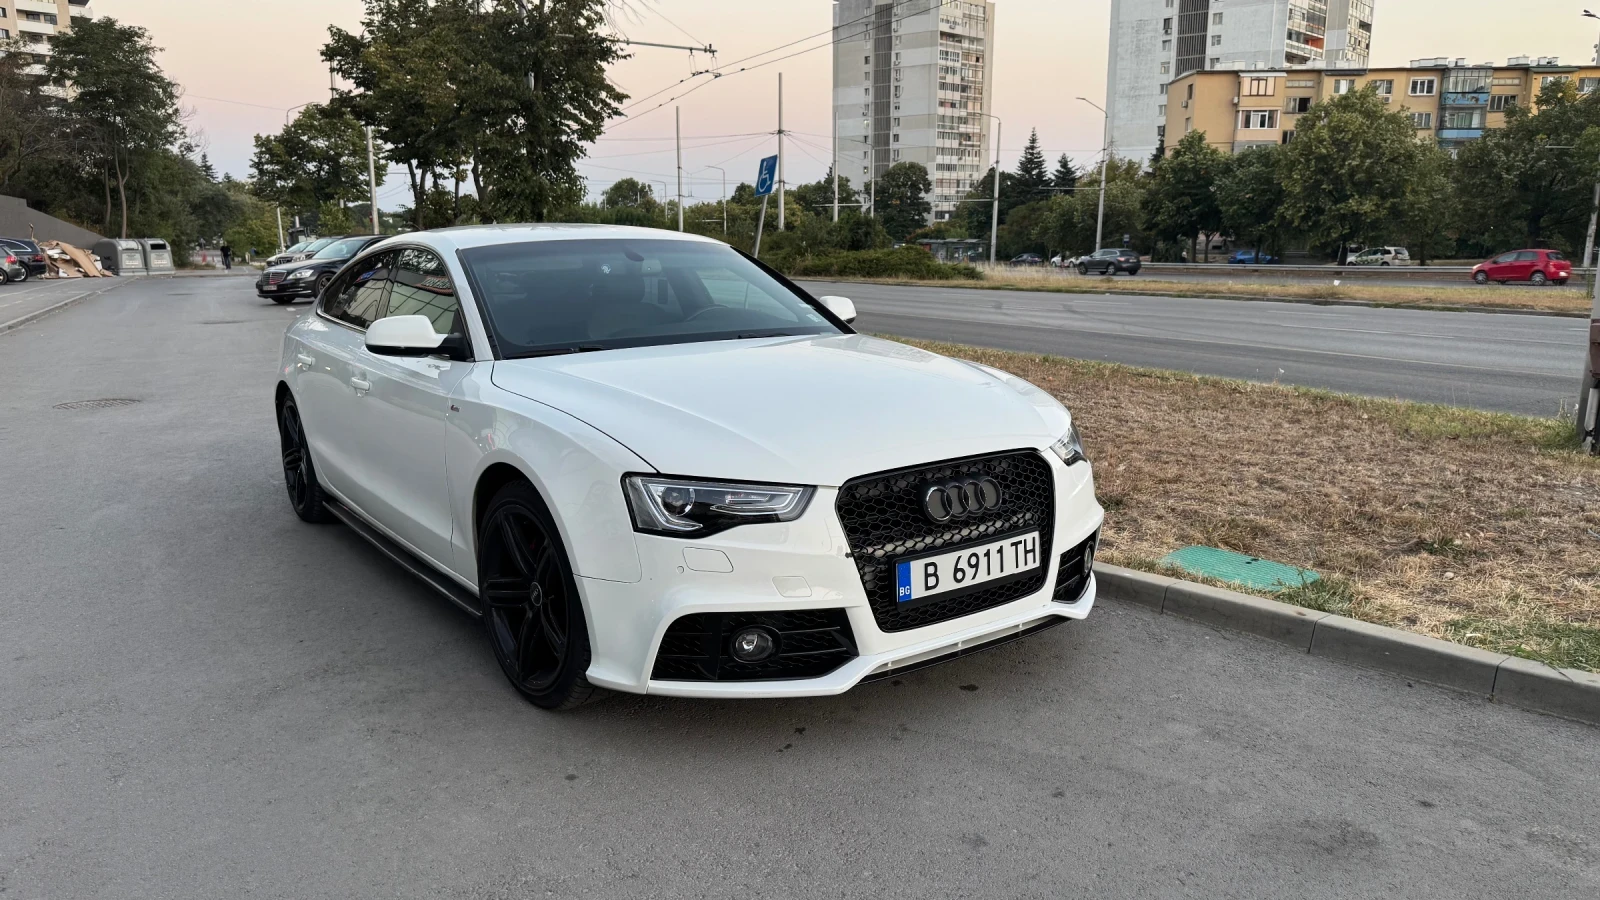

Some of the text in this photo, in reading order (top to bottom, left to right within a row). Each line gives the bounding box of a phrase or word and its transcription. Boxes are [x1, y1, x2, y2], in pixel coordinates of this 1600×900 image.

[924, 536, 1037, 592] B 6911 TH
[899, 586, 911, 596] BG
